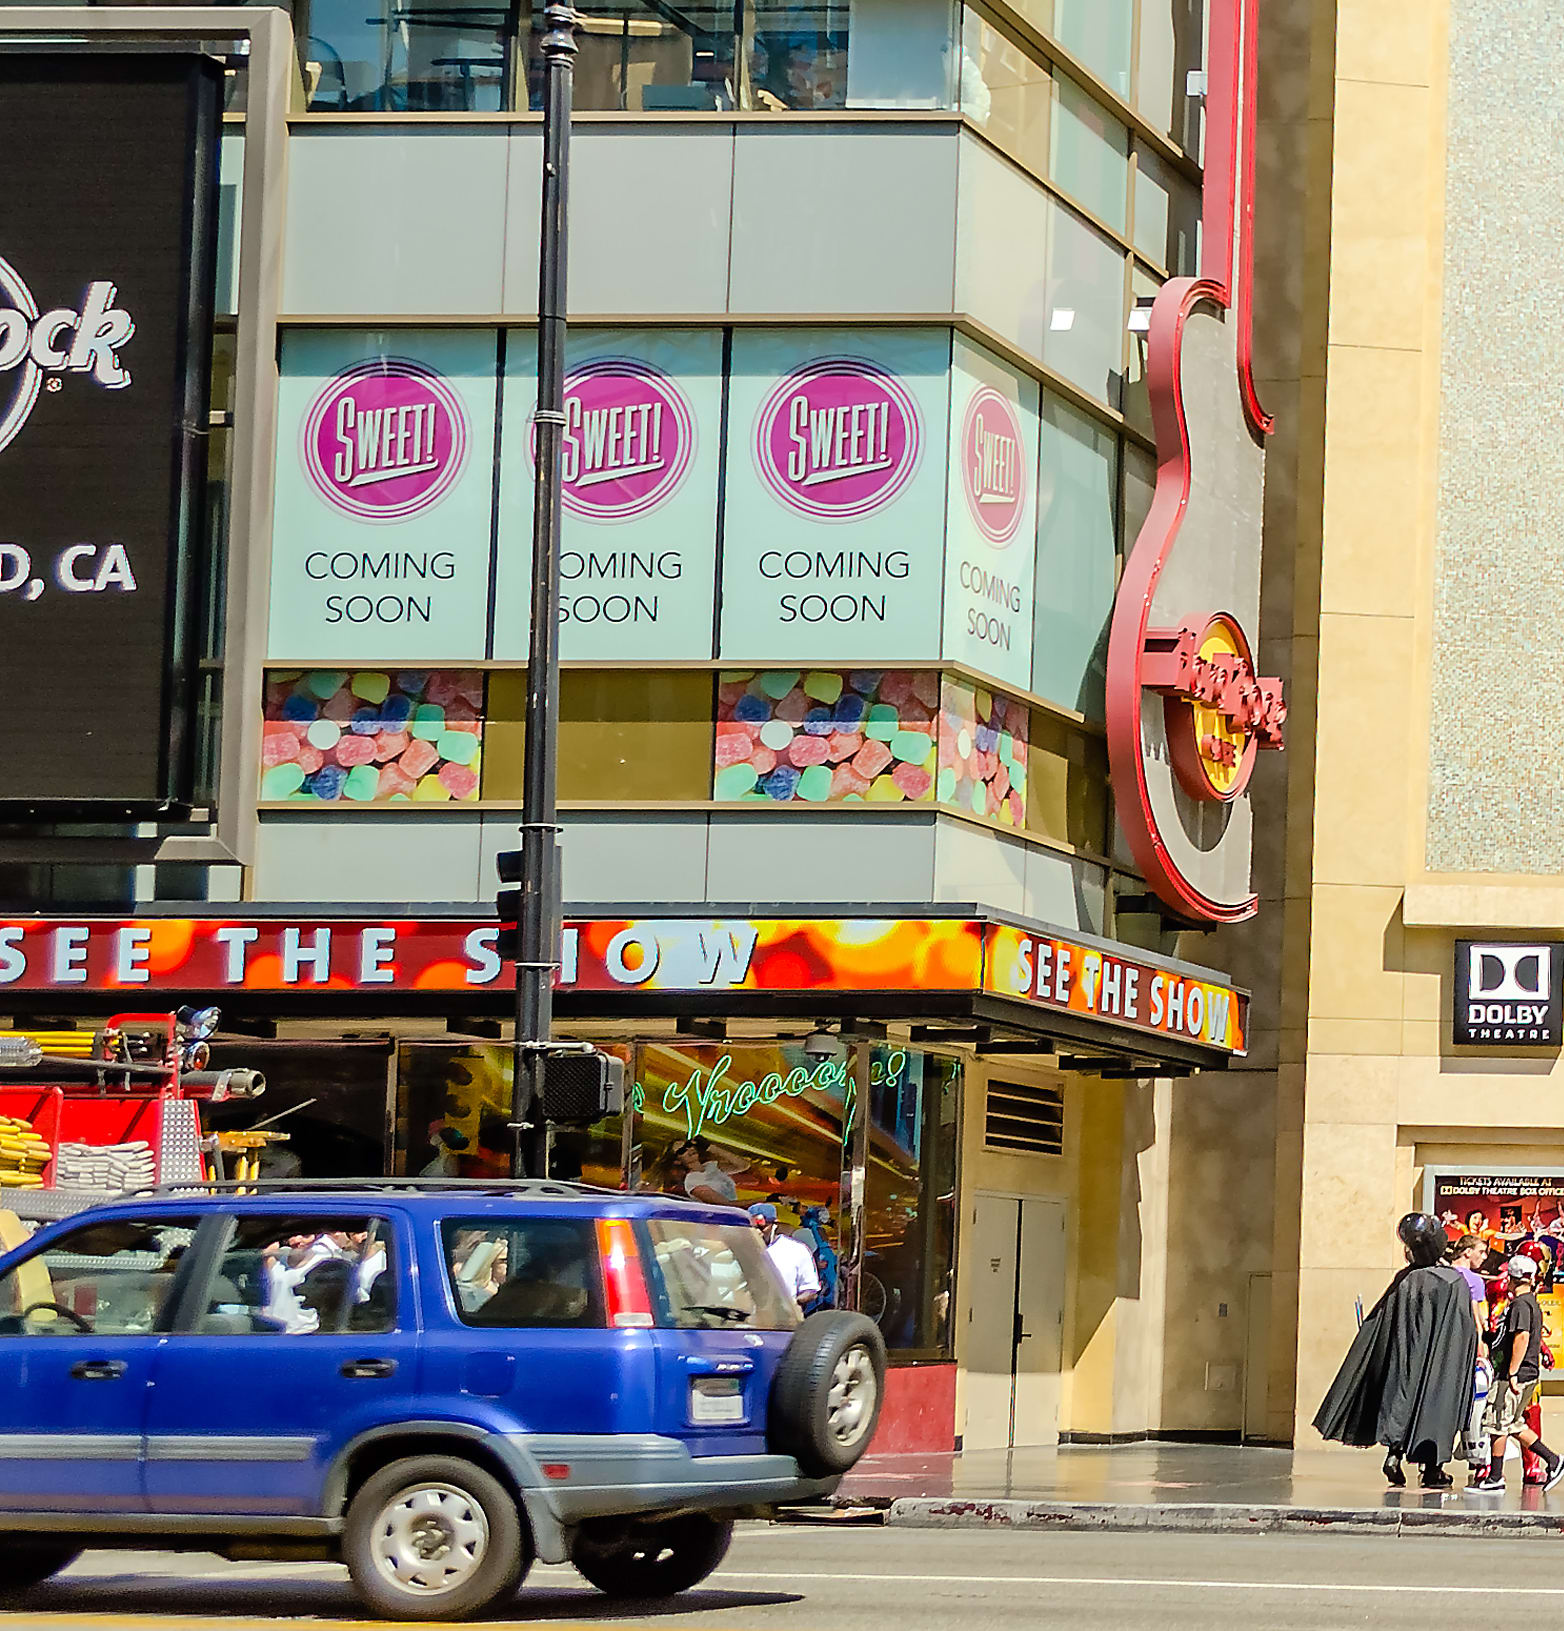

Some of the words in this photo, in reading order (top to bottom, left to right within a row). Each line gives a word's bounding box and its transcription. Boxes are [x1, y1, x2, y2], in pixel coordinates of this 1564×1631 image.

[334, 396, 437, 484] SWEET!
[788, 395, 889, 482] SWEET!
[56, 543, 137, 593] CA
[304, 551, 455, 580] COMING
[560, 551, 683, 580] OMING
[758, 550, 910, 579] COMING
[960, 560, 1022, 614] COMING
[324, 594, 432, 623] SOON
[779, 594, 886, 623] SOON
[967, 607, 1012, 651] SOON
[0, 925, 151, 984] SEE
[216, 925, 395, 984] THE
[1017, 939, 1070, 1003] SEE
[1084, 955, 1138, 1019] THE
[1149, 975, 1230, 1042] SHOW
[1468, 1004, 1549, 1025] DOLBY
[1468, 1028, 1550, 1040] THEATRE
